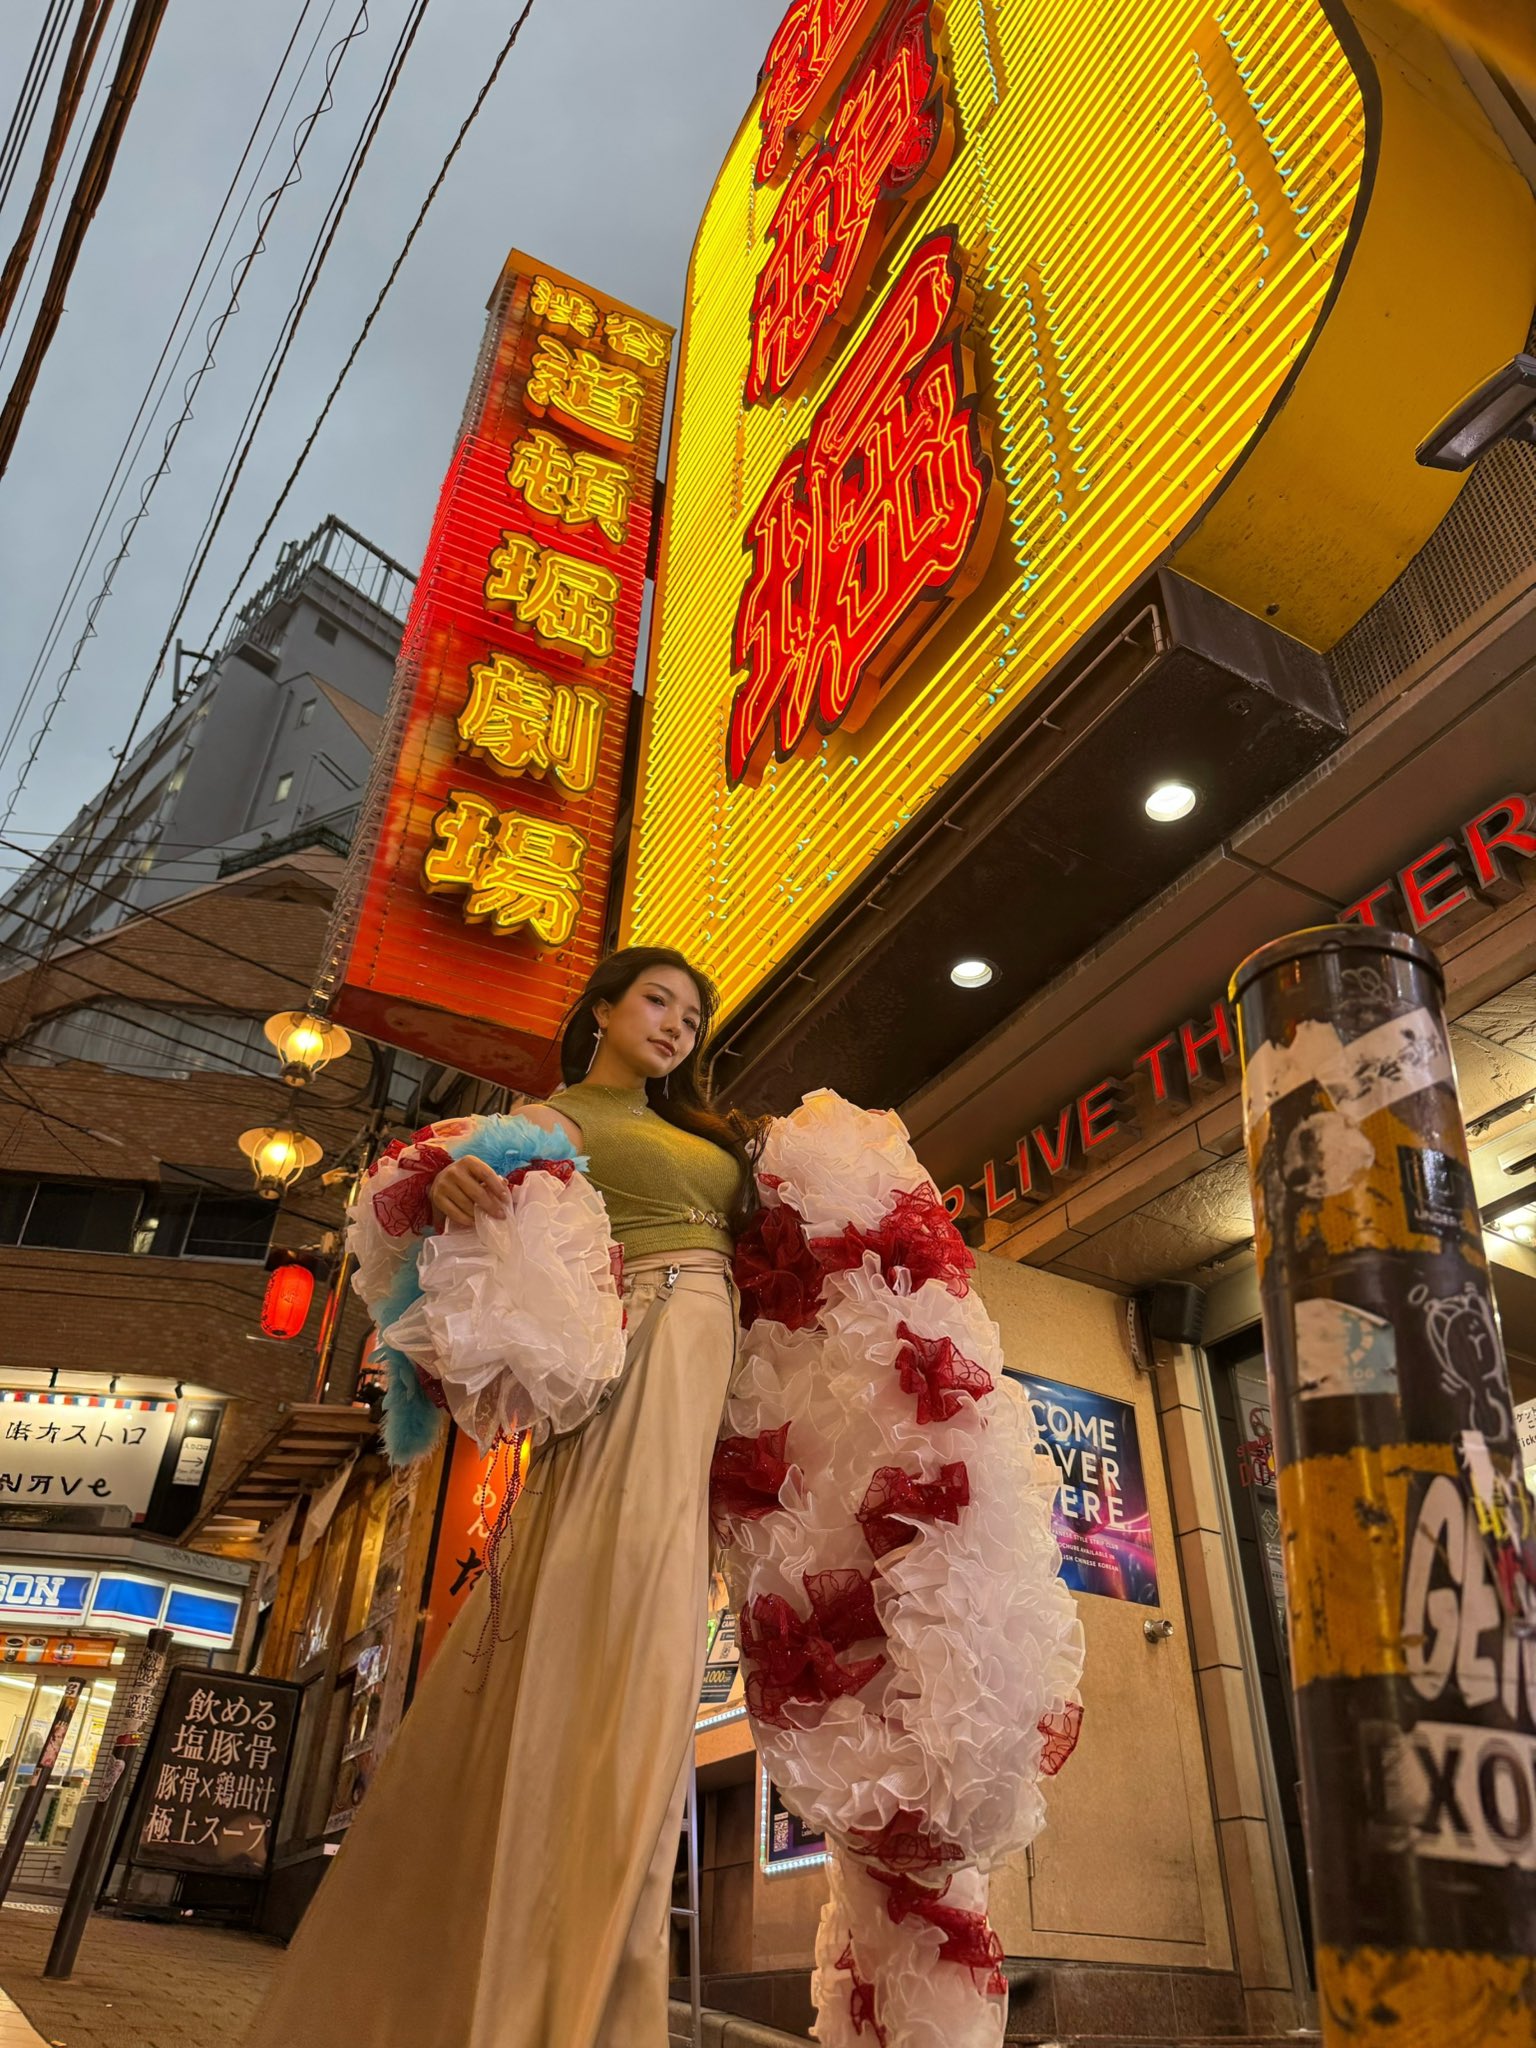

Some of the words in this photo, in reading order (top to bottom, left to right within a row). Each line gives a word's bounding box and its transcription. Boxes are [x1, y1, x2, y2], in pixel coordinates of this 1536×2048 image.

[421, 333, 648, 947] 道頓堀劇場
[983, 1076, 1122, 1219] LIVE
[1030, 1399, 1116, 1453] COME
[1061, 1484, 1125, 1528] ERE
[185, 1687, 277, 1731] 飲める
[171, 1724, 278, 1770] 塩豚骨
[145, 1804, 272, 1852] 極上スープ
